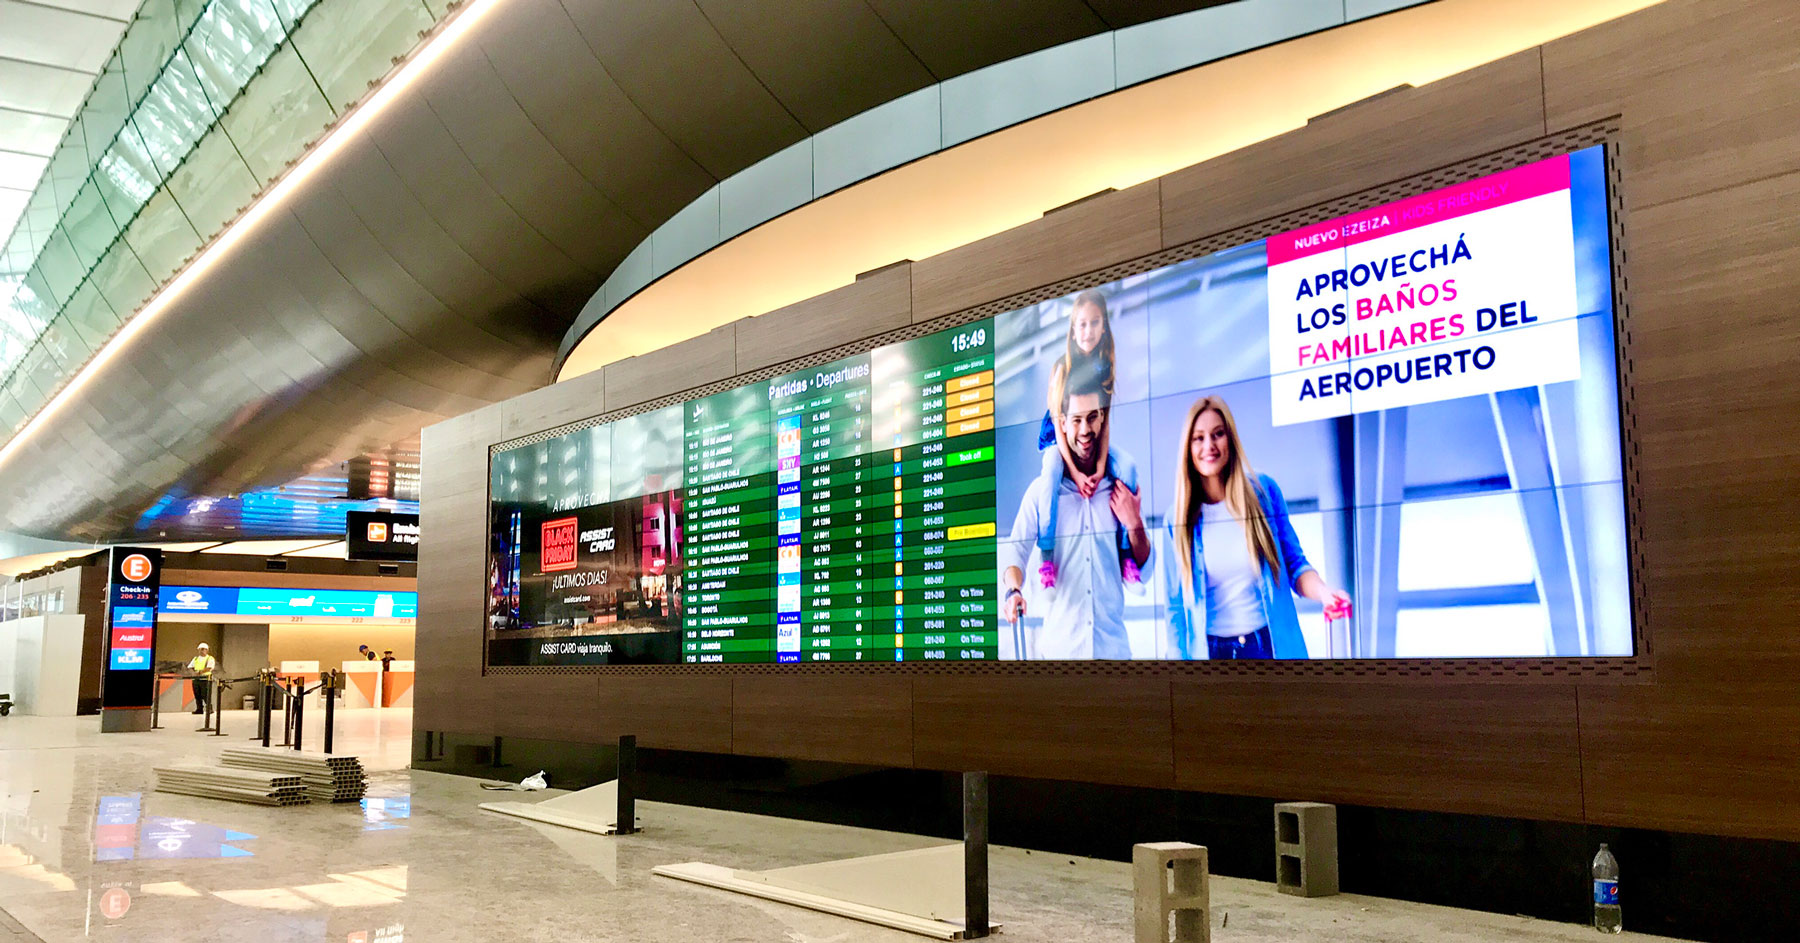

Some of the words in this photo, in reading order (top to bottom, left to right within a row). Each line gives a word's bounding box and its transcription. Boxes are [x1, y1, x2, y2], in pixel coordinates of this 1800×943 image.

[1294, 229, 1338, 250] NUEVO
[1341, 215, 1391, 238] EZEIZA
[1402, 205, 1435, 221] KIDS
[1437, 182, 1509, 213] FRIENDLY
[1296, 232, 1472, 301] APROVECHÁ
[1297, 304, 1346, 334] LOS
[1356, 279, 1458, 321] BAÑOS
[951, 328, 986, 353] 15:49
[1298, 314, 1465, 366] FAMILIARES
[1476, 300, 1538, 331] DEL
[1299, 345, 1497, 401] AEROPUERTO
[768, 379, 808, 401] Partidas
[816, 363, 870, 389] Departures
[960, 453, 972, 462] Took
[973, 450, 982, 460] off
[392, 534, 403, 542] All
[545, 526, 574, 547] BLACK
[580, 527, 614, 543] ASSIST
[545, 544, 574, 564] FRIDAY
[590, 538, 616, 553] CARD
[130, 559, 144, 577] E
[587, 570, 608, 586] DIAS!
[960, 588, 970, 598] On
[970, 588, 984, 597] Time
[960, 604, 970, 613] On
[970, 604, 984, 612] Time
[779, 628, 792, 638] Azul
[960, 619, 970, 628] On
[970, 618, 984, 628] Time
[960, 634, 970, 644] On
[970, 634, 984, 643] Time
[540, 643, 560, 654] ASSIST
[560, 642, 576, 654] CARD
[577, 642, 588, 656] viaja
[960, 650, 970, 659] On
[970, 650, 985, 659] Time
[118, 656, 144, 664] KLM
